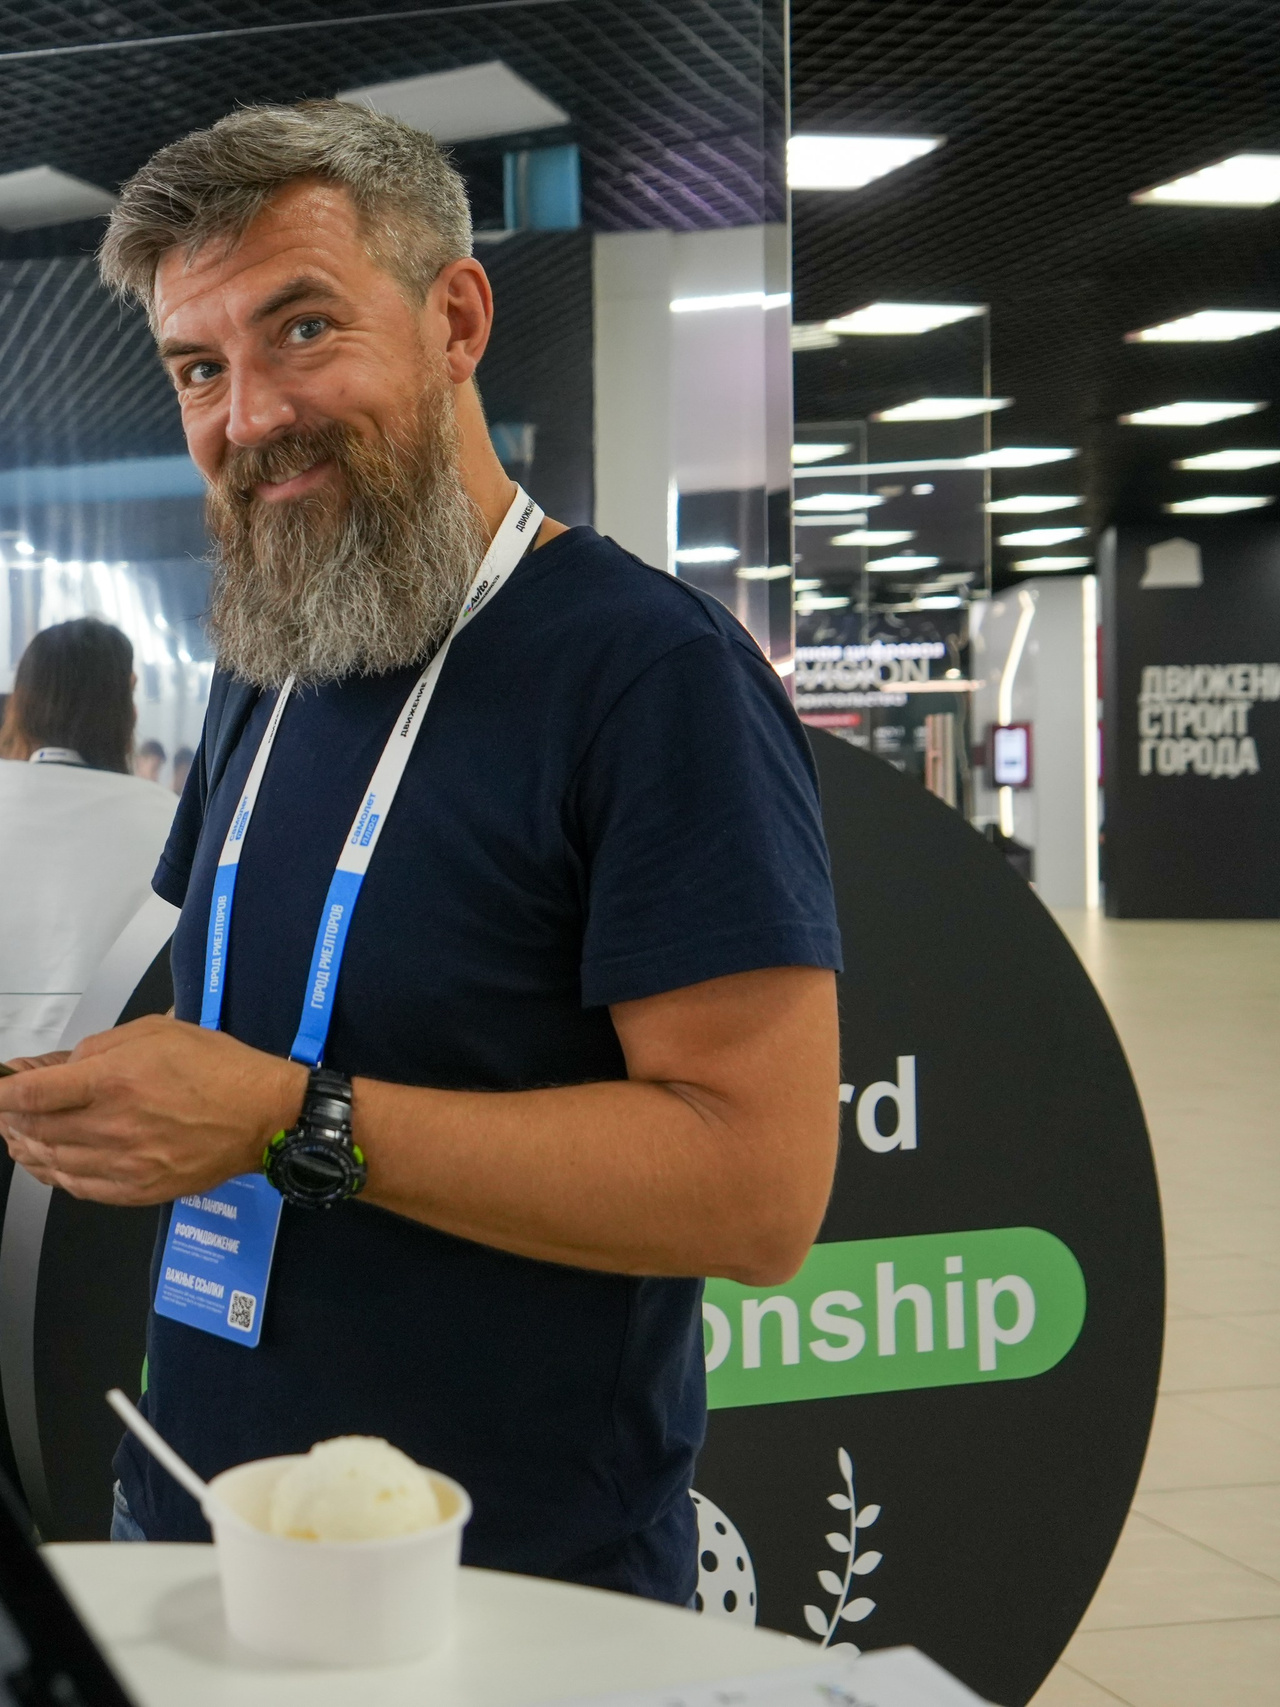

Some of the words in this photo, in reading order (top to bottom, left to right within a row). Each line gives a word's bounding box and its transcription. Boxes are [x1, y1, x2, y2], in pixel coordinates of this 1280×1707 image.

[471, 580, 489, 608] Avito
[401, 682, 427, 737] ДВИЖЕНИЕ
[1138, 699, 1254, 739] СТРОИТ
[1139, 736, 1260, 779] ГОРОДА
[213, 895, 227, 956] РИЕЛТОРОВ
[318, 904, 344, 970] РИЕЛТОРОВ
[209, 957, 222, 992] ГОРОД
[311, 971, 330, 1009] ГОРОД
[201, 1198, 238, 1219] ПАНОРАМА
[174, 1222, 240, 1254] #ФОРУМДВИЖЕНИЕ
[165, 1267, 195, 1289] ВАЖНЫЕ
[194, 1278, 225, 1299] ССЫЛКИ
